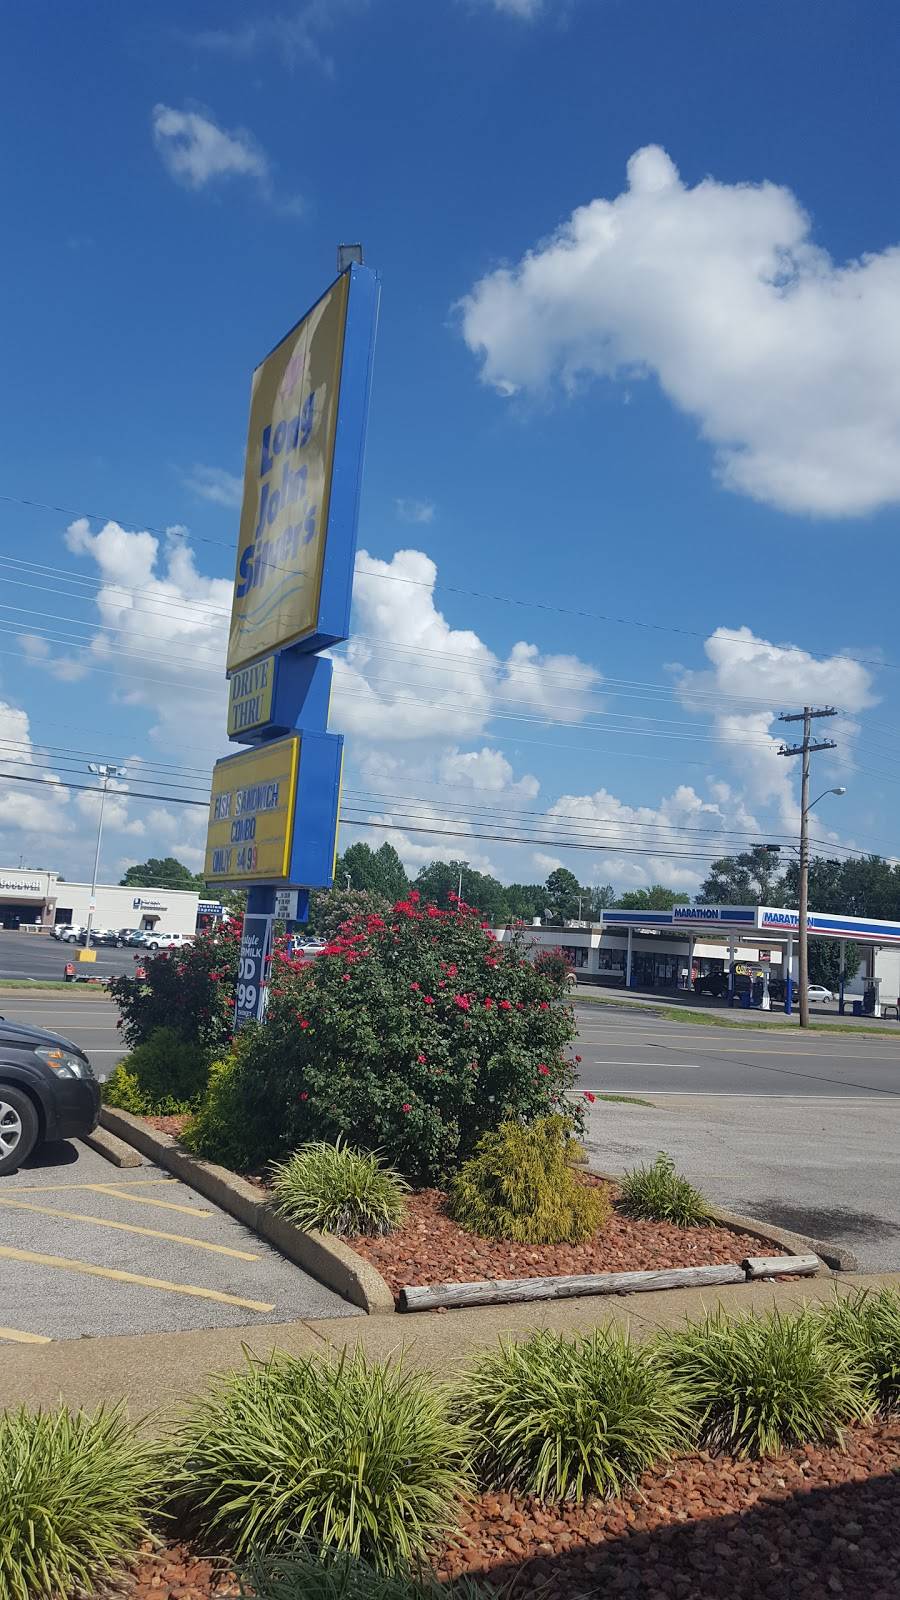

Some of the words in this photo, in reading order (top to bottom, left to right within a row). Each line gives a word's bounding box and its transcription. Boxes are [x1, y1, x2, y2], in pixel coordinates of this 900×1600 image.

[261, 391, 315, 478] Long
[255, 461, 308, 540] John
[236, 505, 317, 598] Silver's
[232, 662, 269, 700] DRIVE
[232, 694, 265, 730] THRU
[214, 792, 231, 819] FISH
[235, 783, 279, 817] SANDWICH
[231, 817, 256, 842] COMBO
[212, 848, 231, 873] ONLY
[674, 908, 719, 919] MARATHON
[763, 912, 815, 927] MARATHN
[237, 982, 257, 1009] 99
